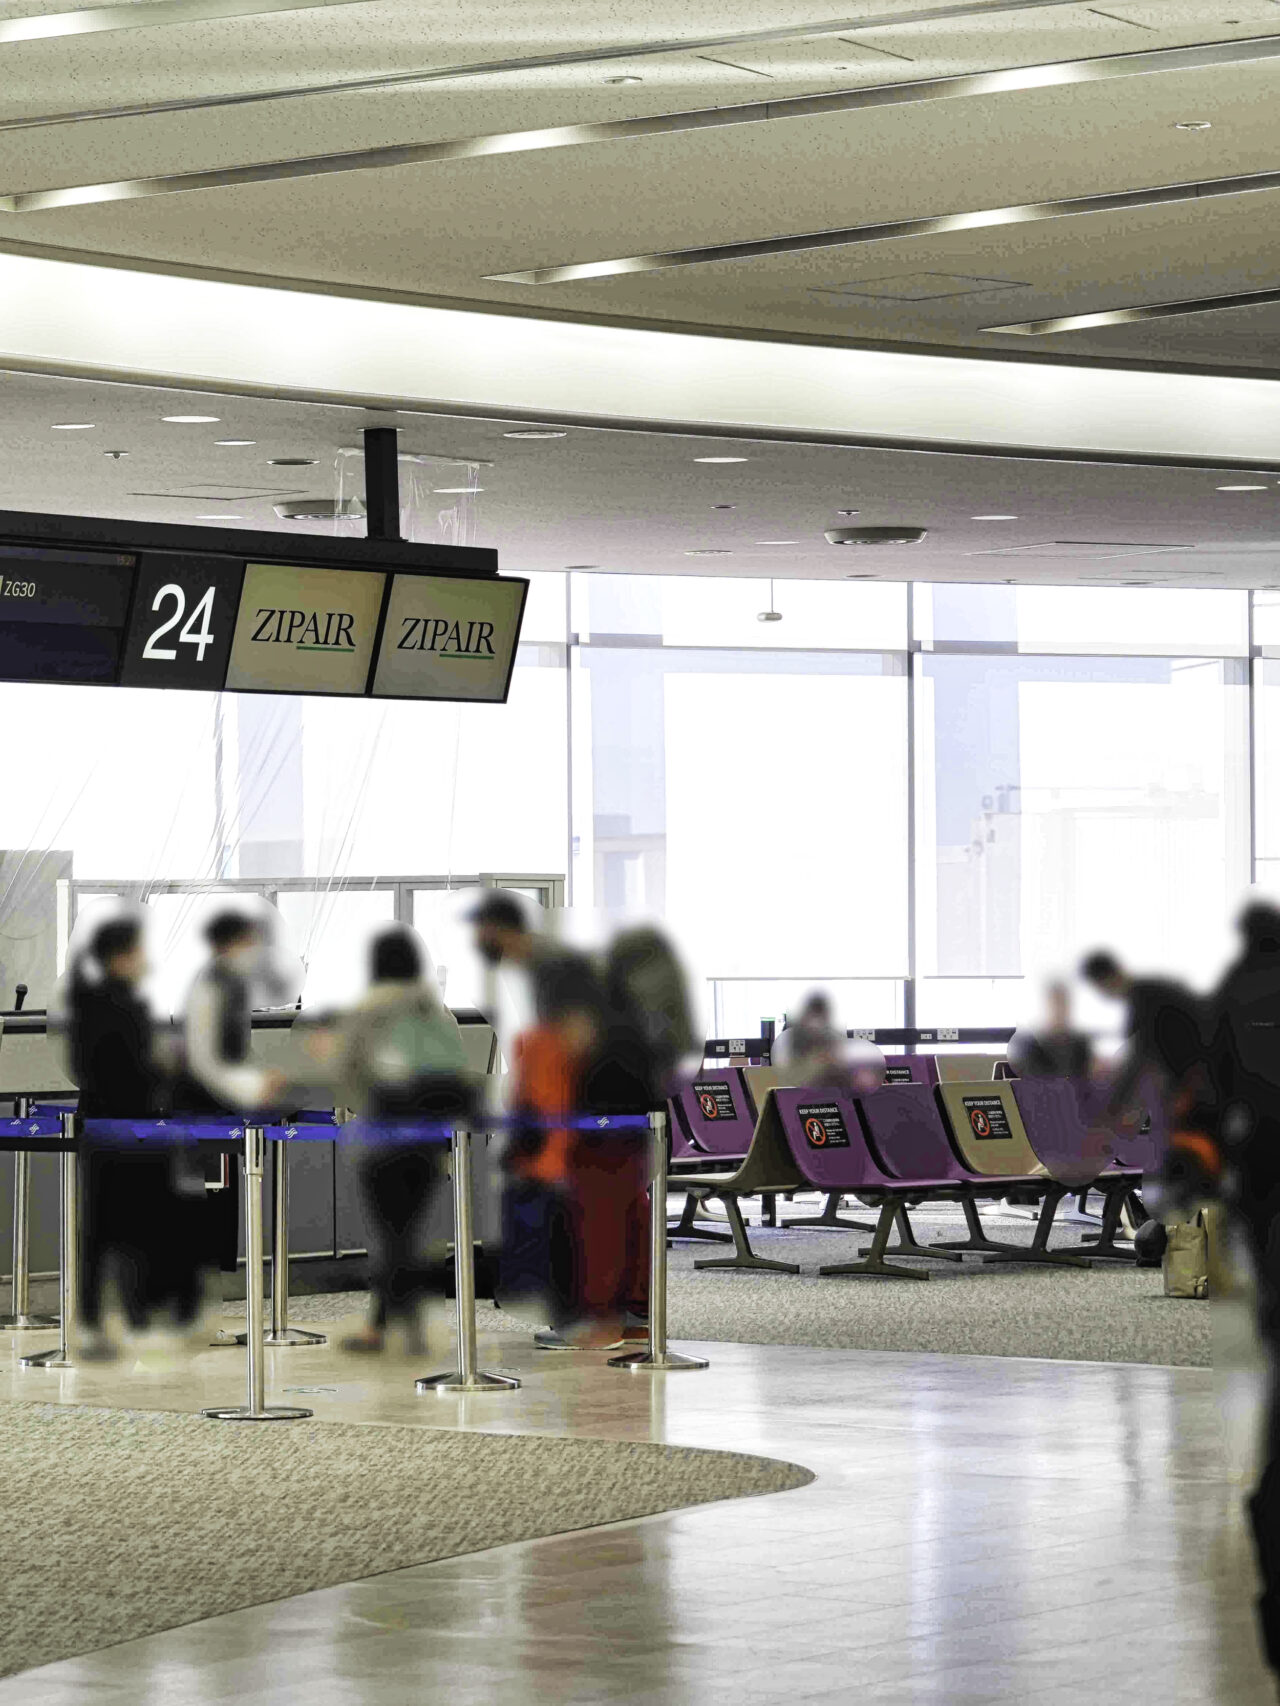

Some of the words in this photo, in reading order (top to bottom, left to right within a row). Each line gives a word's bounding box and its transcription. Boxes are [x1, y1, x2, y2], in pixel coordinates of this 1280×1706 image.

[4, 580, 36, 598] ZG30
[142, 583, 216, 662] 24
[251, 608, 356, 647] ZIPAIR
[397, 617, 495, 654] ZIPAIR
